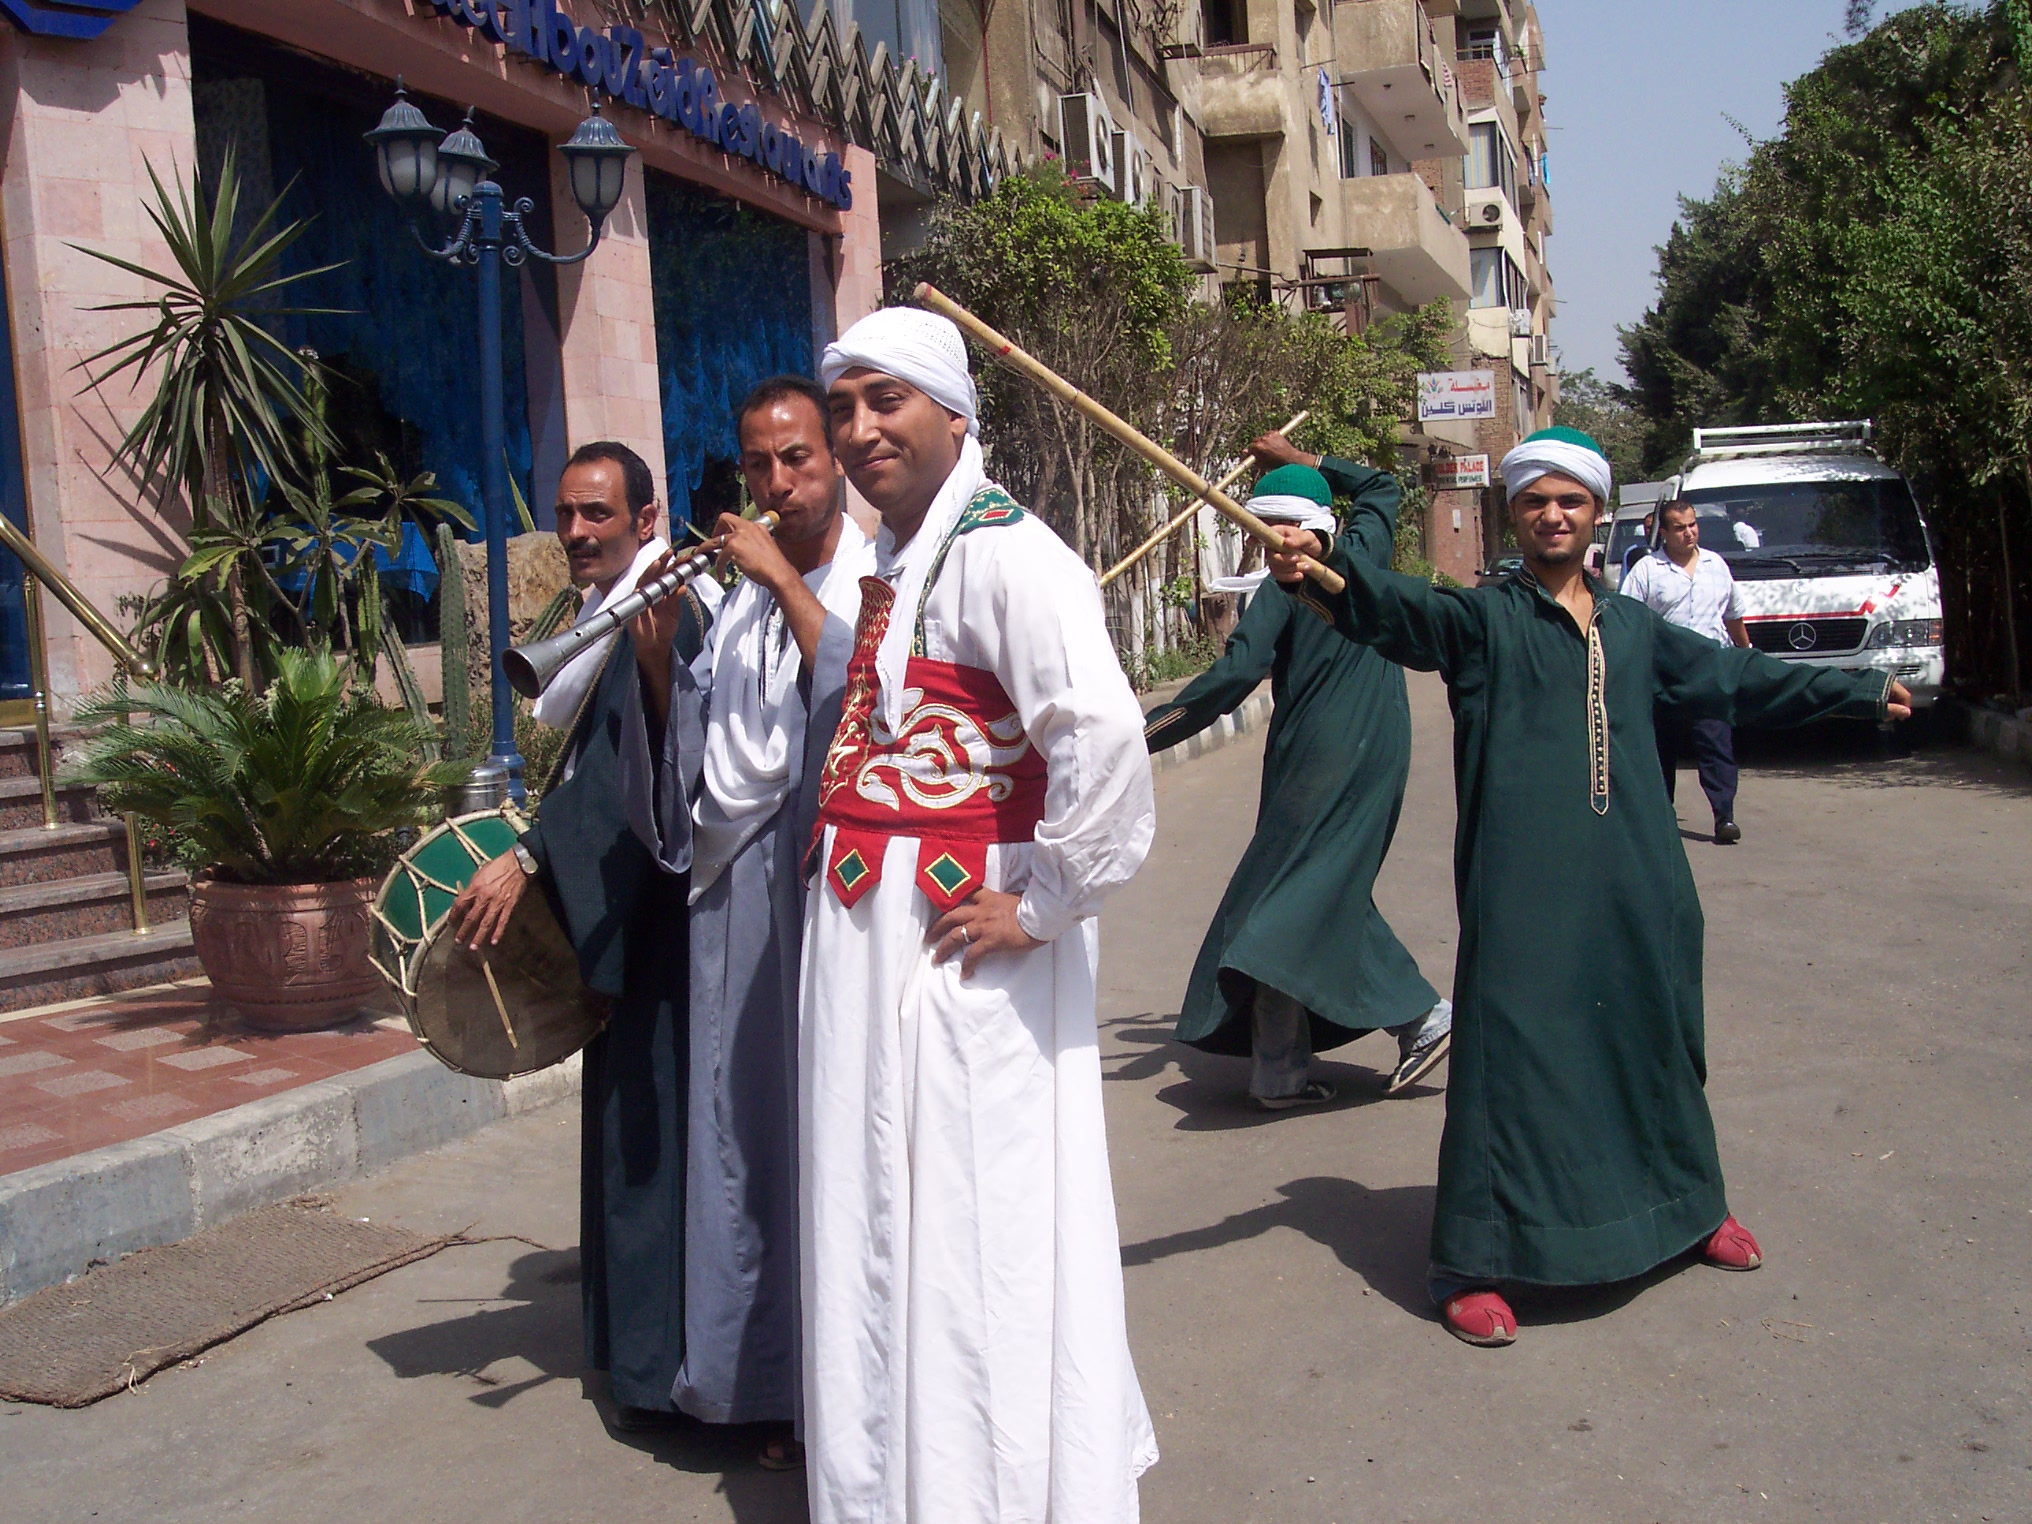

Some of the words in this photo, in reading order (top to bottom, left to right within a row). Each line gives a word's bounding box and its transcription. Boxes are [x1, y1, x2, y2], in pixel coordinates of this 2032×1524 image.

[1448, 378, 1490, 391] مغسلة
[1422, 401, 1455, 417] كلين
[1458, 400, 1492, 415] اللوتس
[1460, 460, 1484, 473] PALACE
